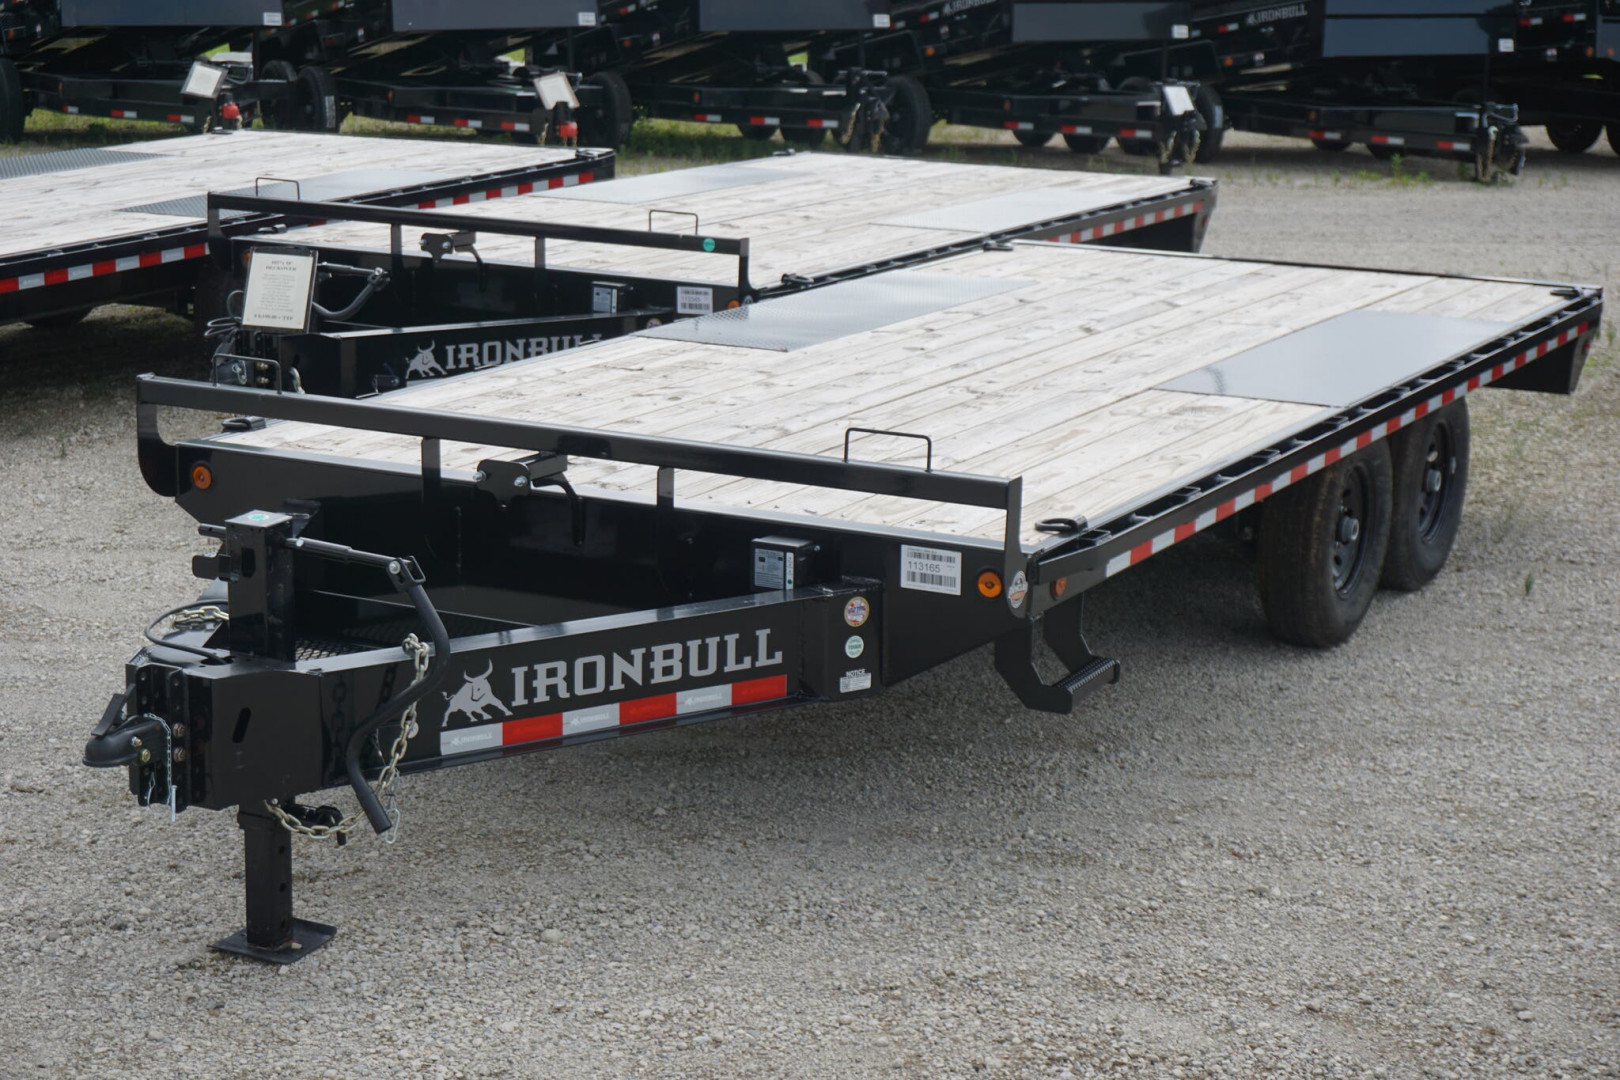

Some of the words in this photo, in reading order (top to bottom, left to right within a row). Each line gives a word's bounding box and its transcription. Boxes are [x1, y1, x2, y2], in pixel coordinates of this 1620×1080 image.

[952, 0, 997, 12] IRONB
[1257, 3, 1308, 23] IRONBULL
[908, 560, 941, 573] 113165
[511, 628, 783, 707] IRONBULL
